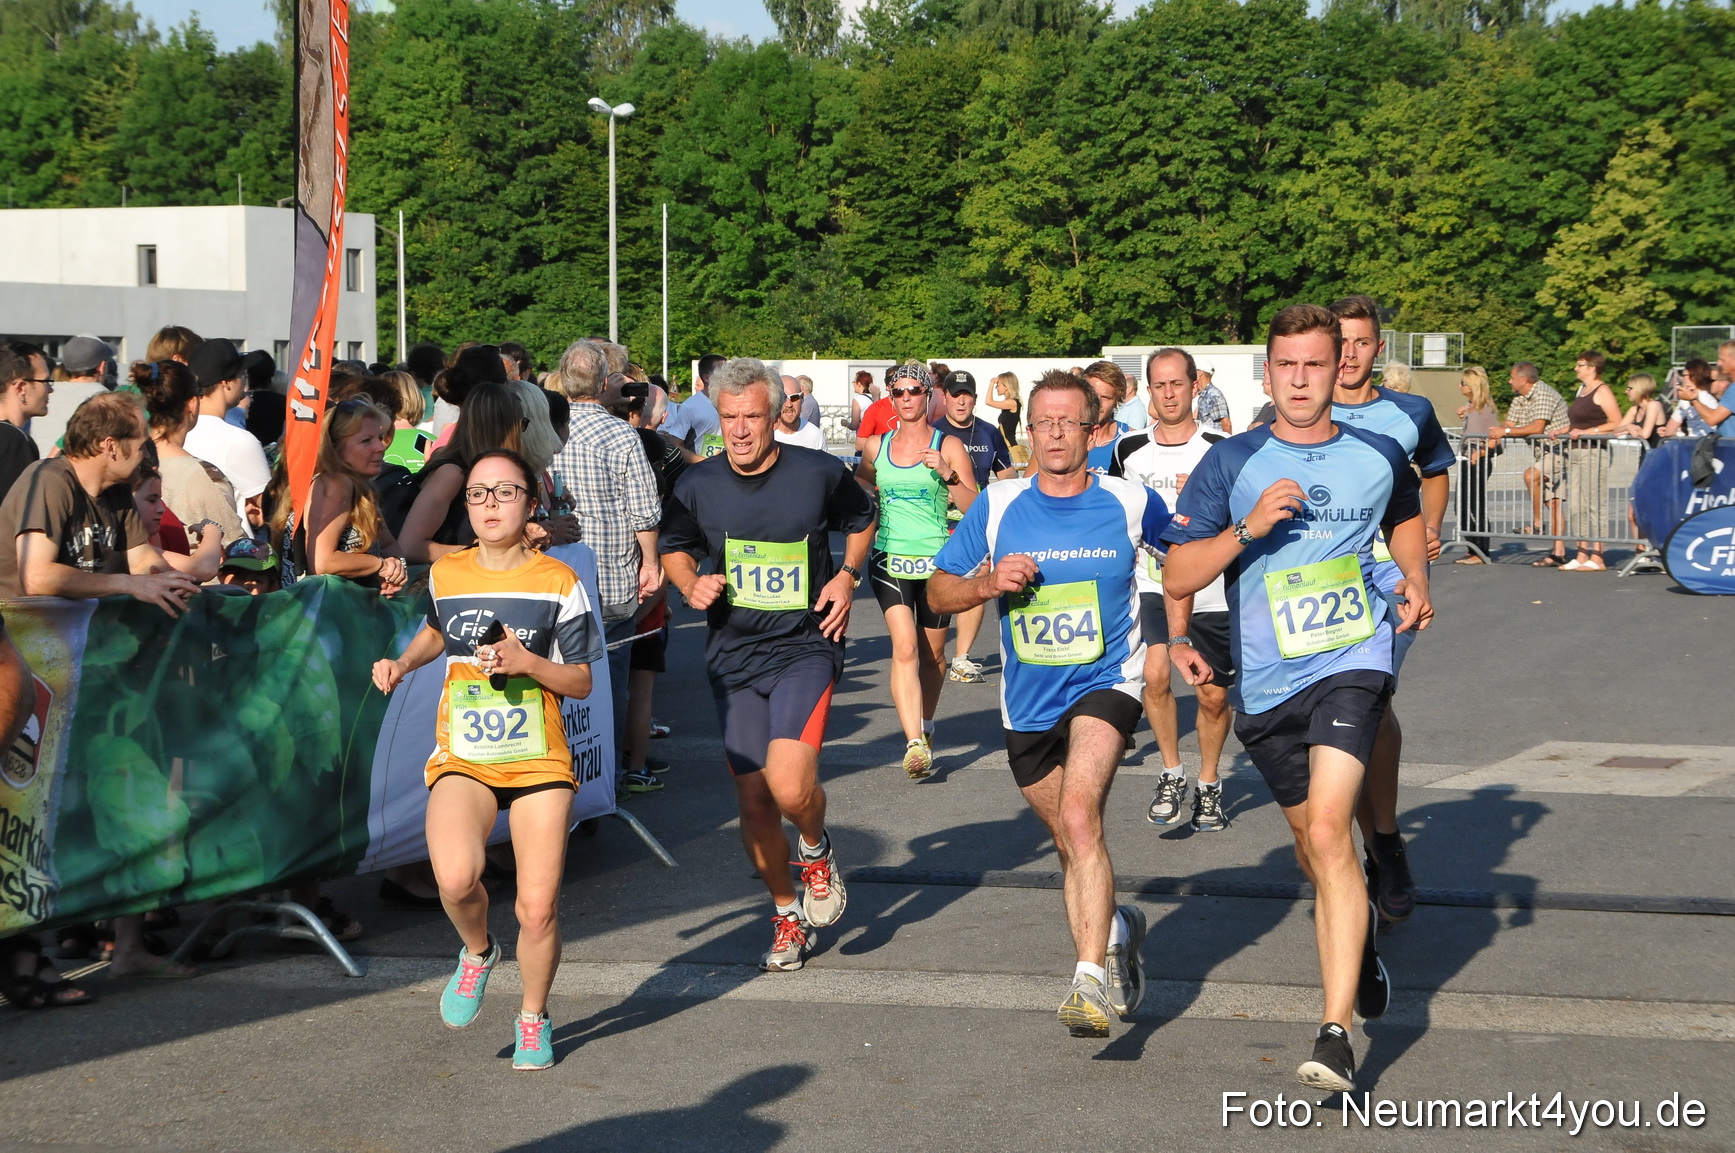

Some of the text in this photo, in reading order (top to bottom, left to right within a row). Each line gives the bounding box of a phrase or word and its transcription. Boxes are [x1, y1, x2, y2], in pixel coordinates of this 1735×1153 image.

[1290, 507, 1374, 522] ABMÜLLER
[1302, 530, 1333, 540] TEAM
[730, 564, 800, 593] 1181
[1277, 586, 1365, 635] 1223
[460, 620, 538, 641] Fiser
[1014, 610, 1099, 646] 1264
[1310, 626, 1343, 639] Peter Bogner
[463, 707, 529, 743] 392
[473, 742, 494, 750] Kristine
